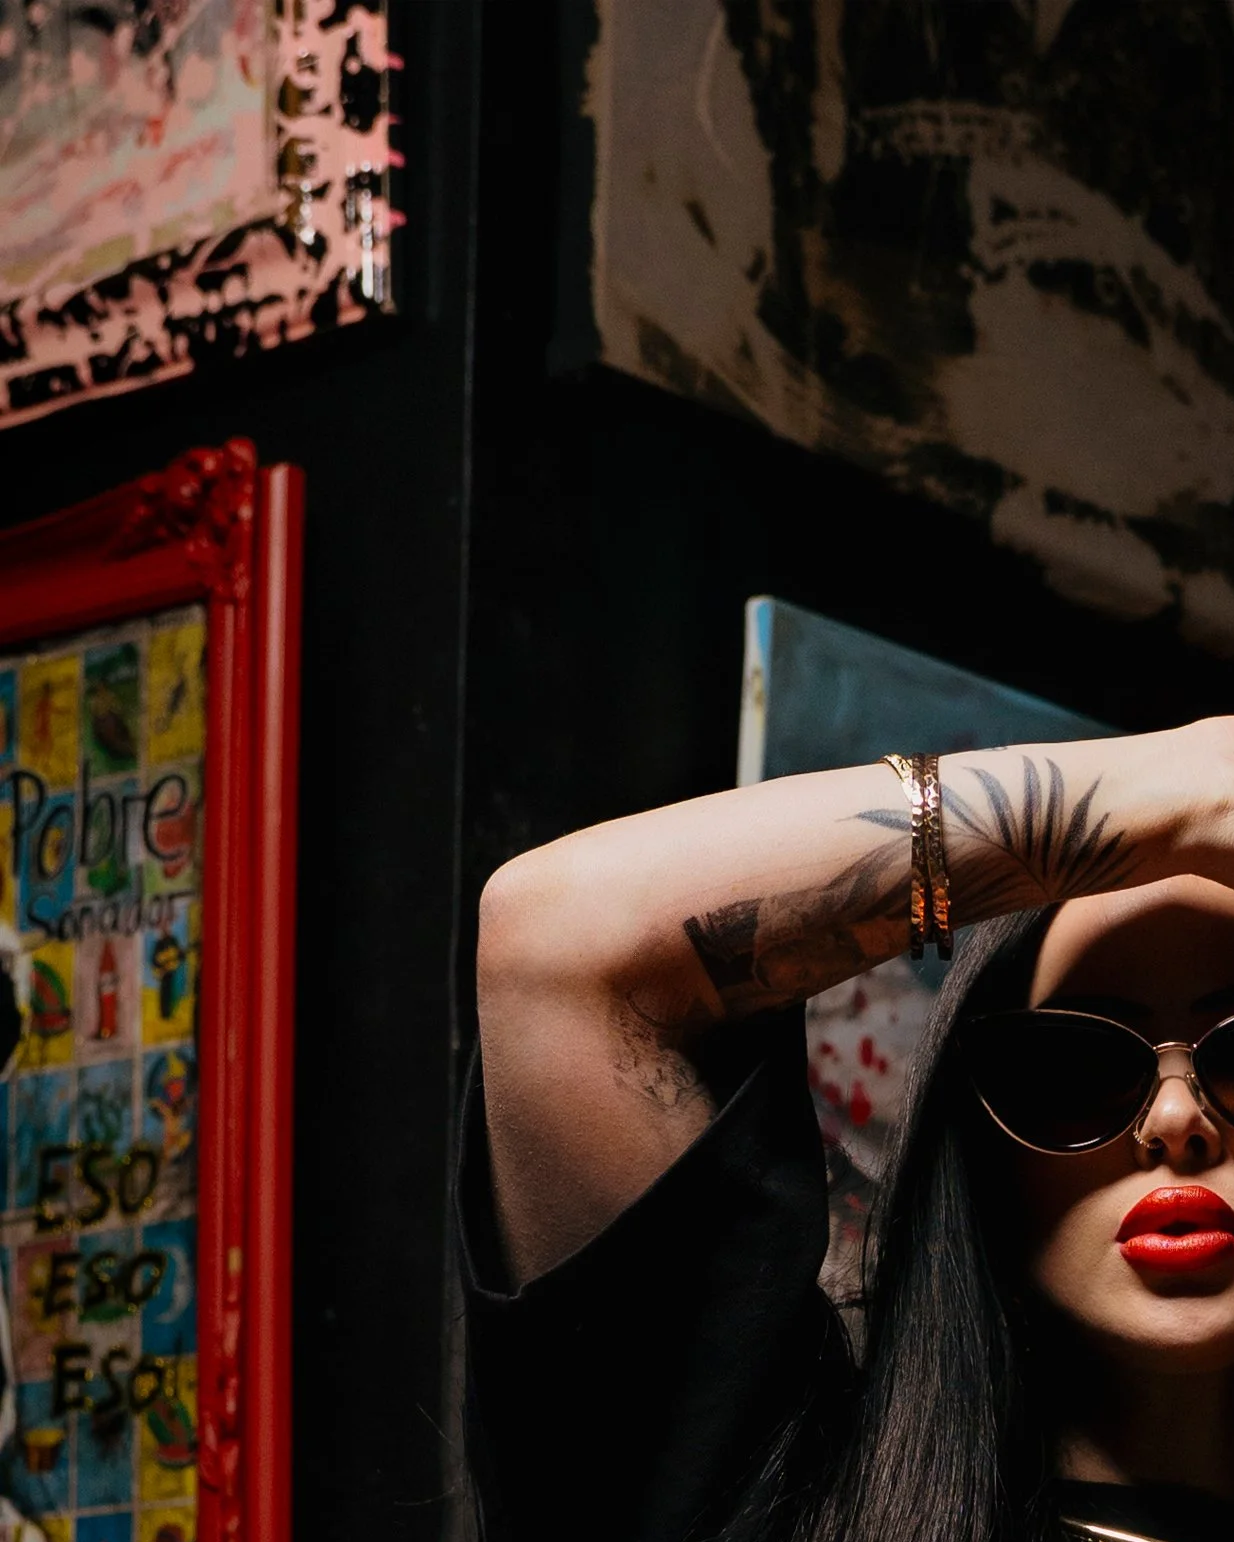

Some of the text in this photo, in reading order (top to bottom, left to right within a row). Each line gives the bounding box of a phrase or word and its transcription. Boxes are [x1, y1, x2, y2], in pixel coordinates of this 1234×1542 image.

[10, 758, 187, 882] Pobre
[37, 1144, 158, 1231] ESO
[45, 1250, 166, 1317] ESO
